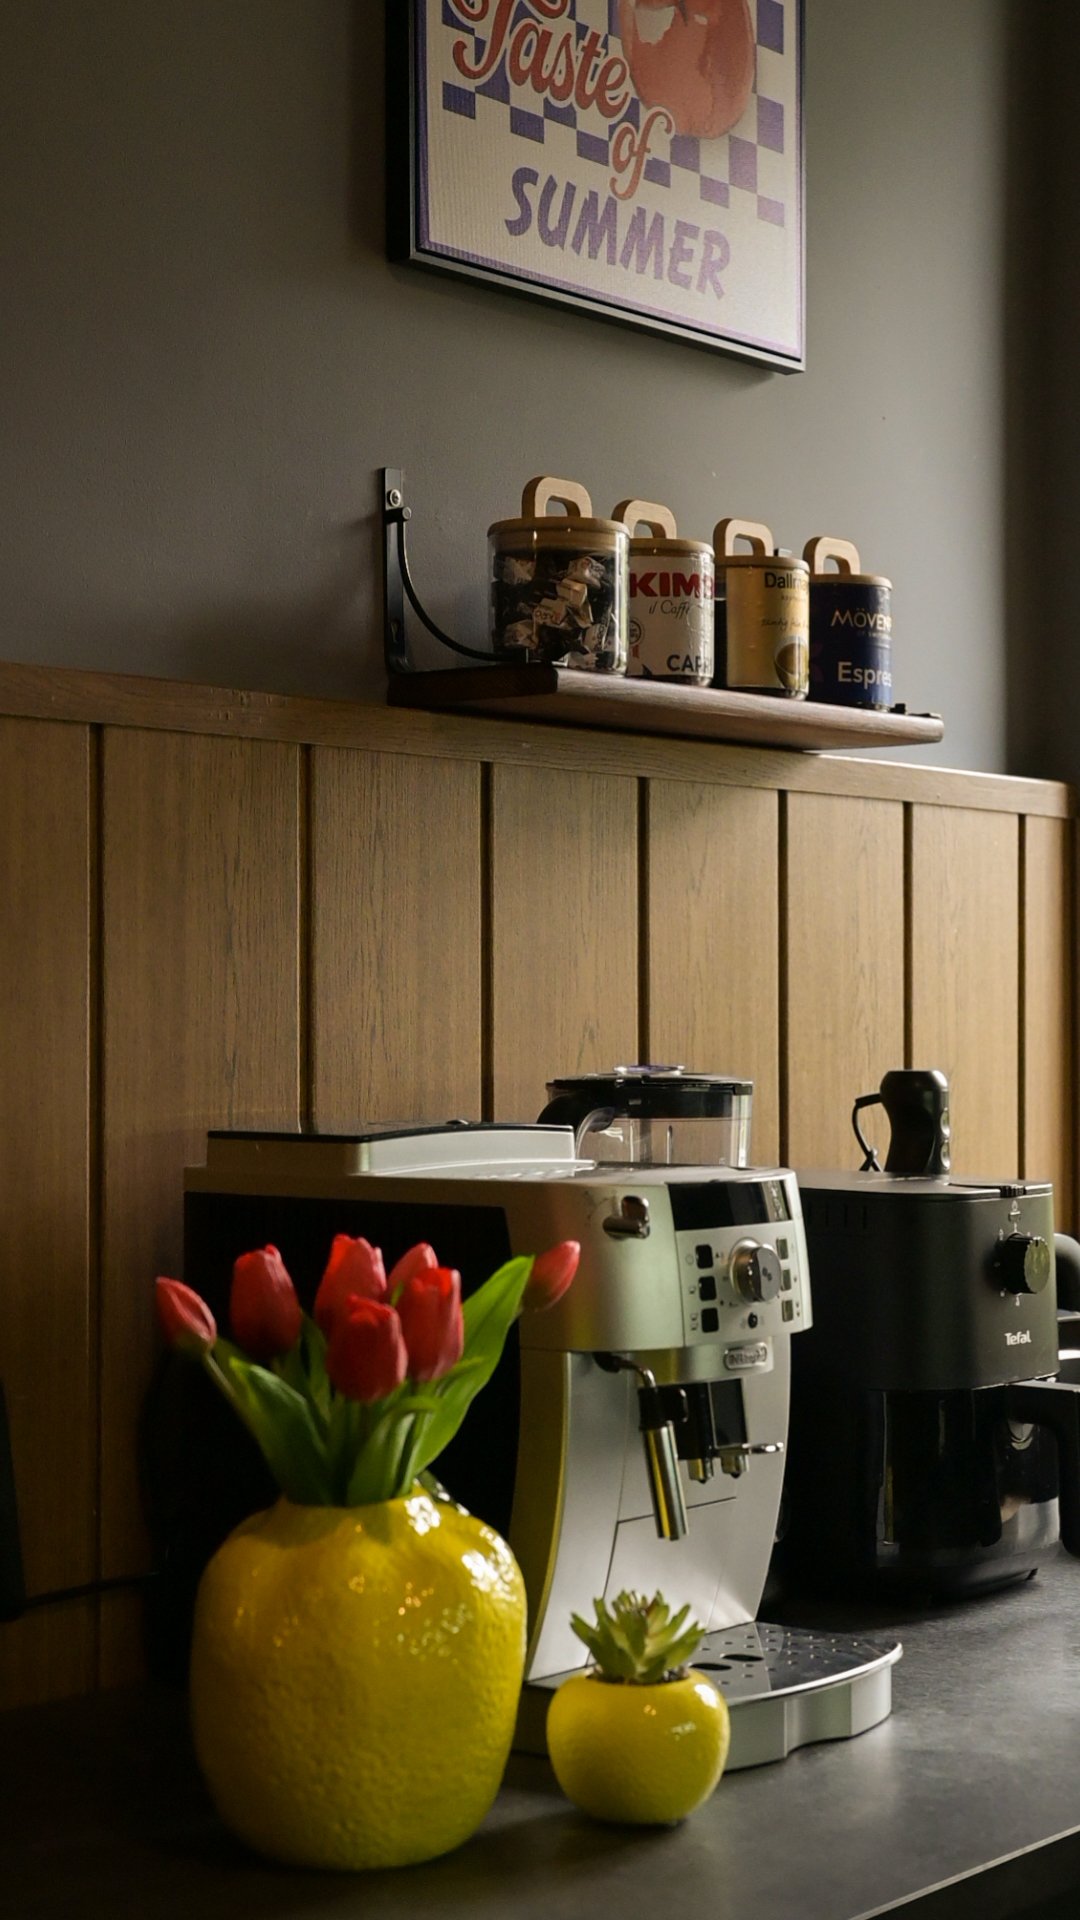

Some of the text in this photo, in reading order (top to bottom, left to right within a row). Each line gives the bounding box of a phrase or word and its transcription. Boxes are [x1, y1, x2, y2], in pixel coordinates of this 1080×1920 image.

[609, 110, 674, 200] of
[504, 166, 731, 300] SUMMER
[1004, 1330, 1032, 1346] Tefal
